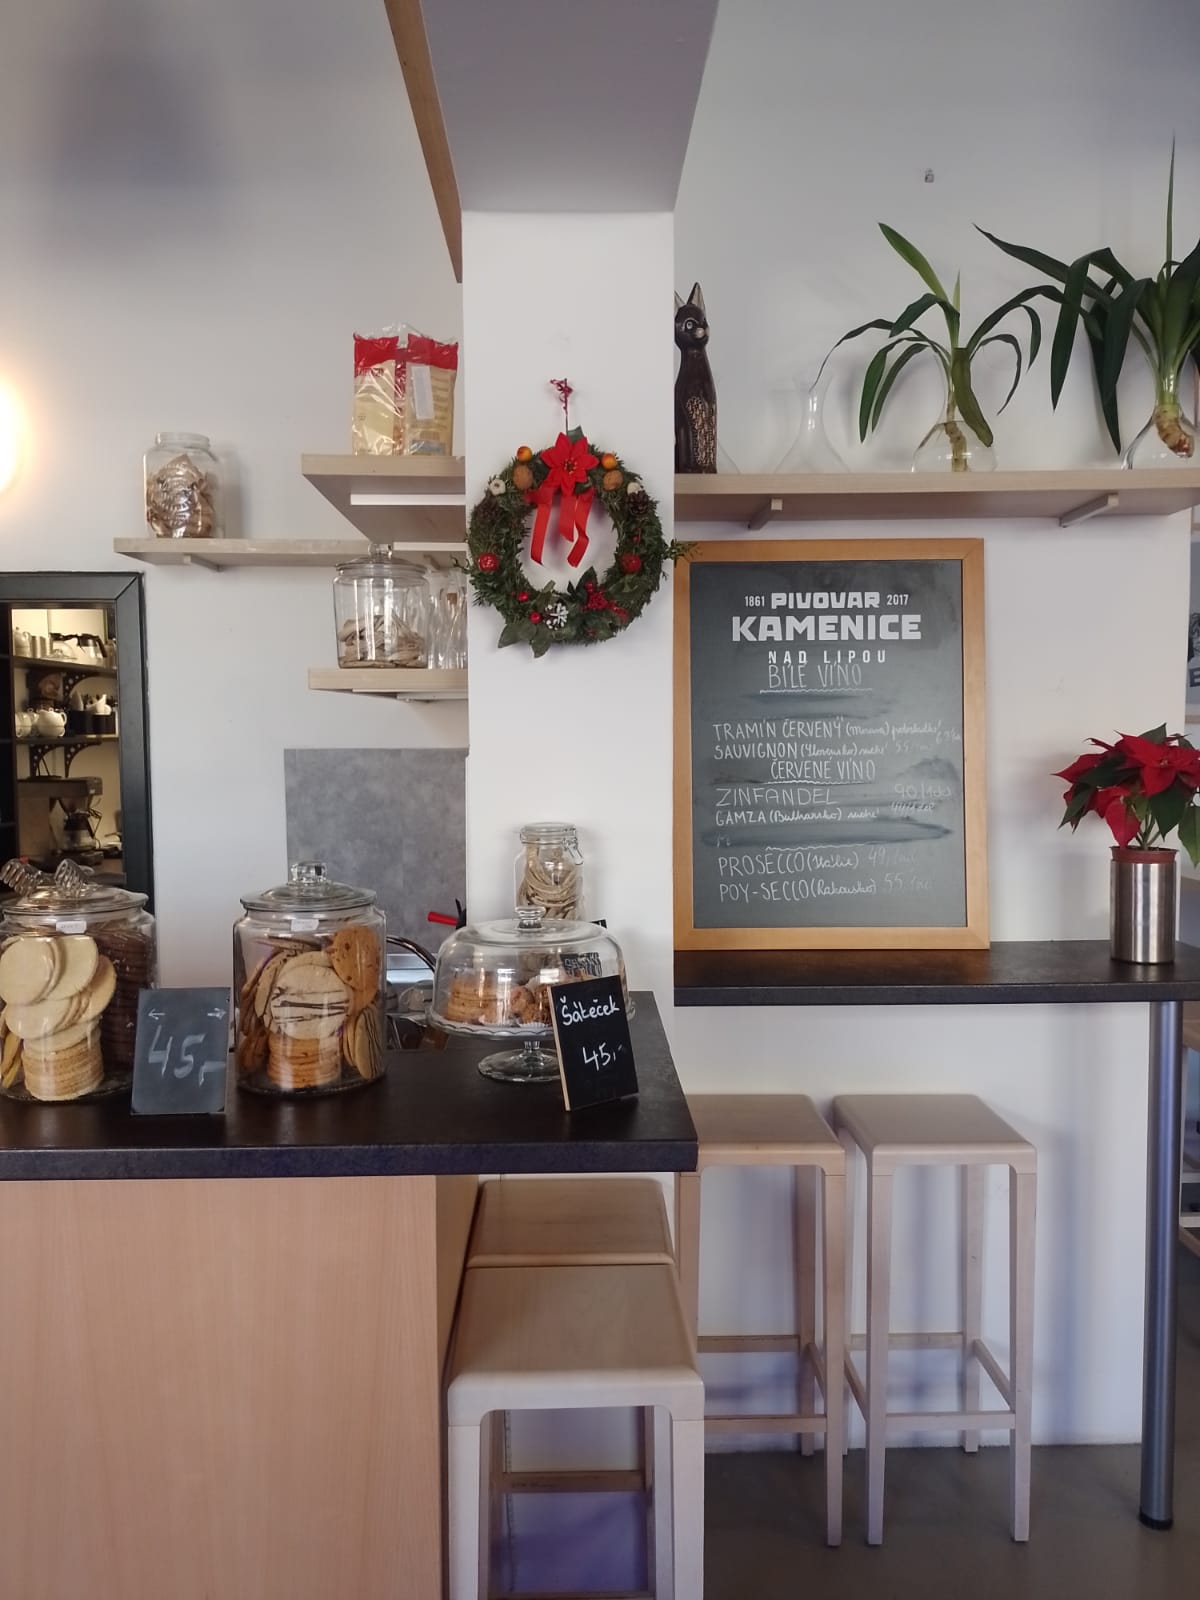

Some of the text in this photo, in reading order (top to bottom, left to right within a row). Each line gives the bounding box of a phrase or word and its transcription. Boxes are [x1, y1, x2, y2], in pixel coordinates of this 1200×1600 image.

[745, 591, 909, 609] 1861 PIVOVAR 2017
[731, 613, 922, 642] KAMENICE
[768, 649, 886, 664] NAD LIPOU
[817, 661, 862, 688] VÍNO
[712, 718, 777, 741] TRAMÍN
[782, 716, 844, 739] ČERVENÝ
[714, 742, 798, 760] SAUVIGNON
[770, 757, 876, 781] ČERVENÉ VÍNO
[715, 788, 840, 807] ZINFANDEL
[715, 809, 767, 826] GAMZA
[718, 852, 805, 877] PROSECCO
[719, 879, 810, 904] POY-SECCO
[559, 995, 621, 1026] Šáteček
